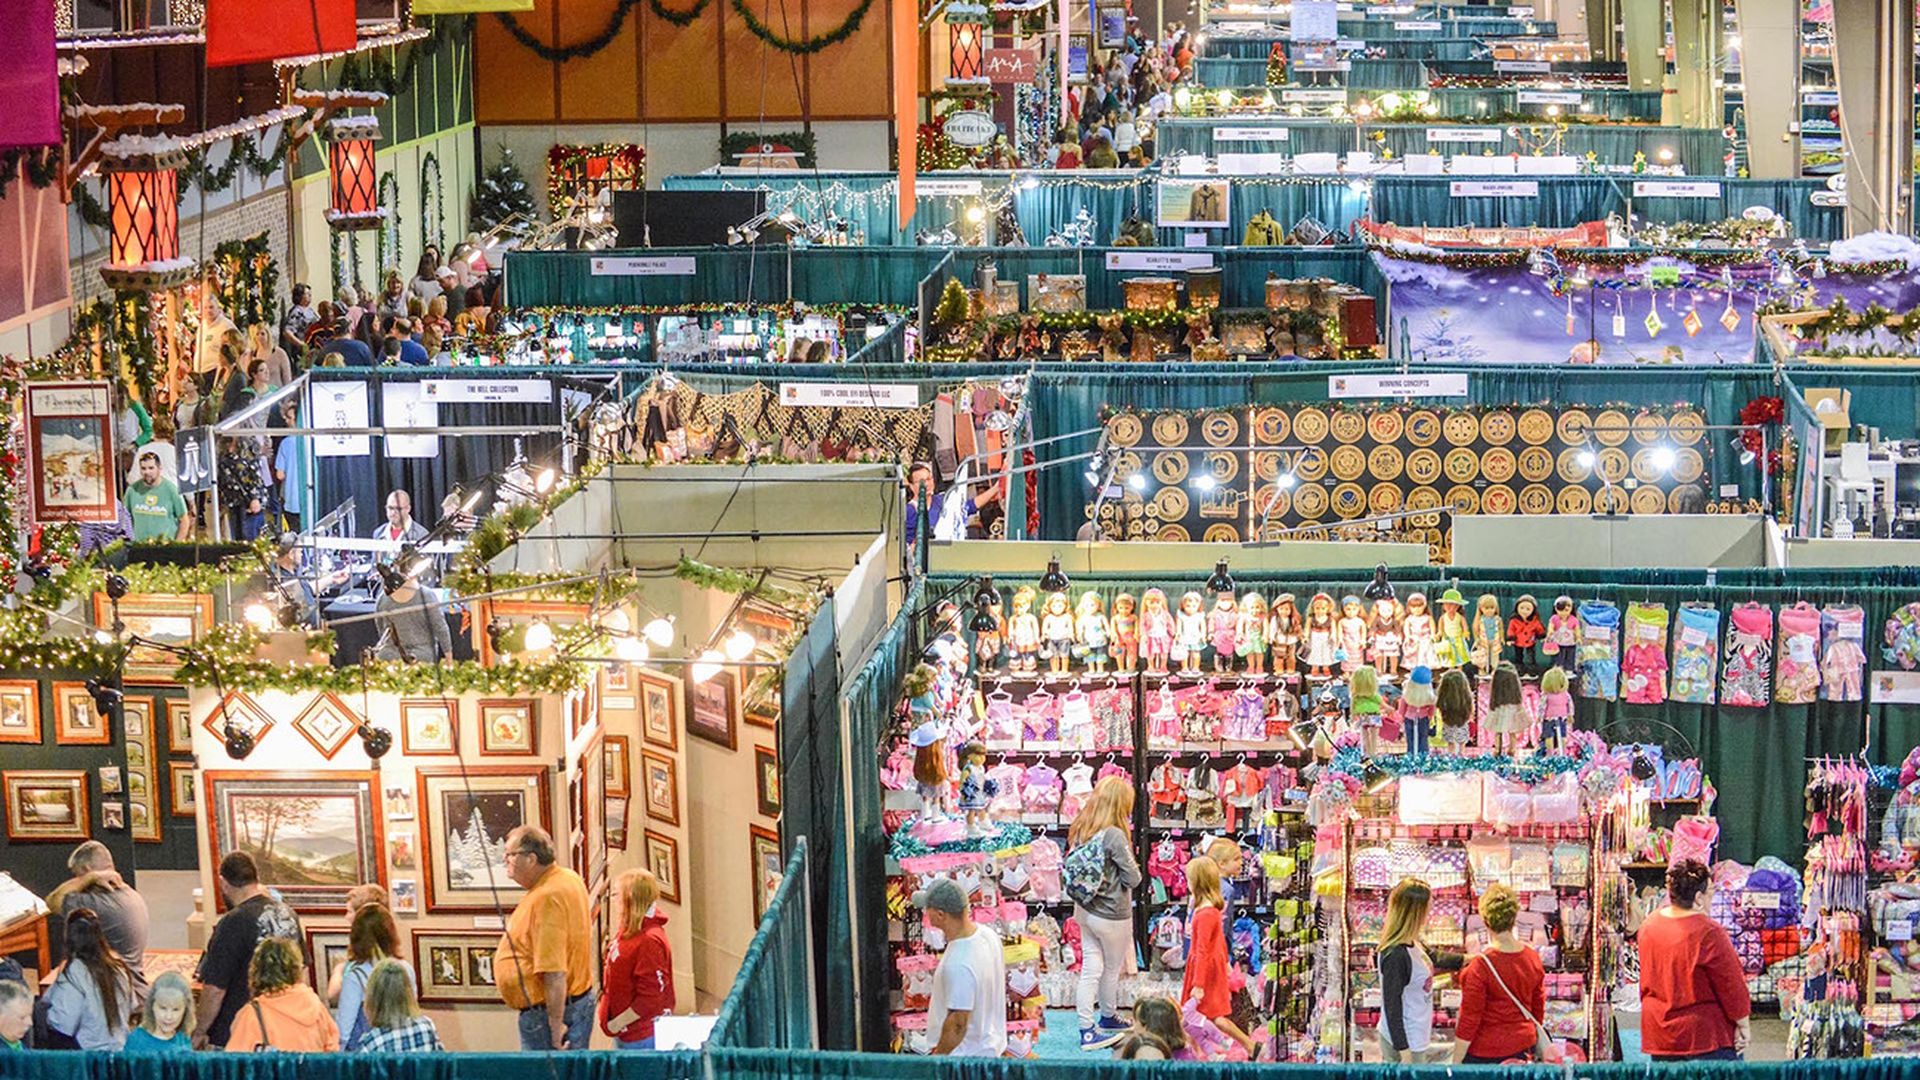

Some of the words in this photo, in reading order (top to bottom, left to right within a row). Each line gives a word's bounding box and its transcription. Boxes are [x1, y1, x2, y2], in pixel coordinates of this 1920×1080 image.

[1403, 379, 1429, 387] CONCEPTS
[467, 385, 476, 393] THE
[490, 385, 519, 393] COLLECTION
